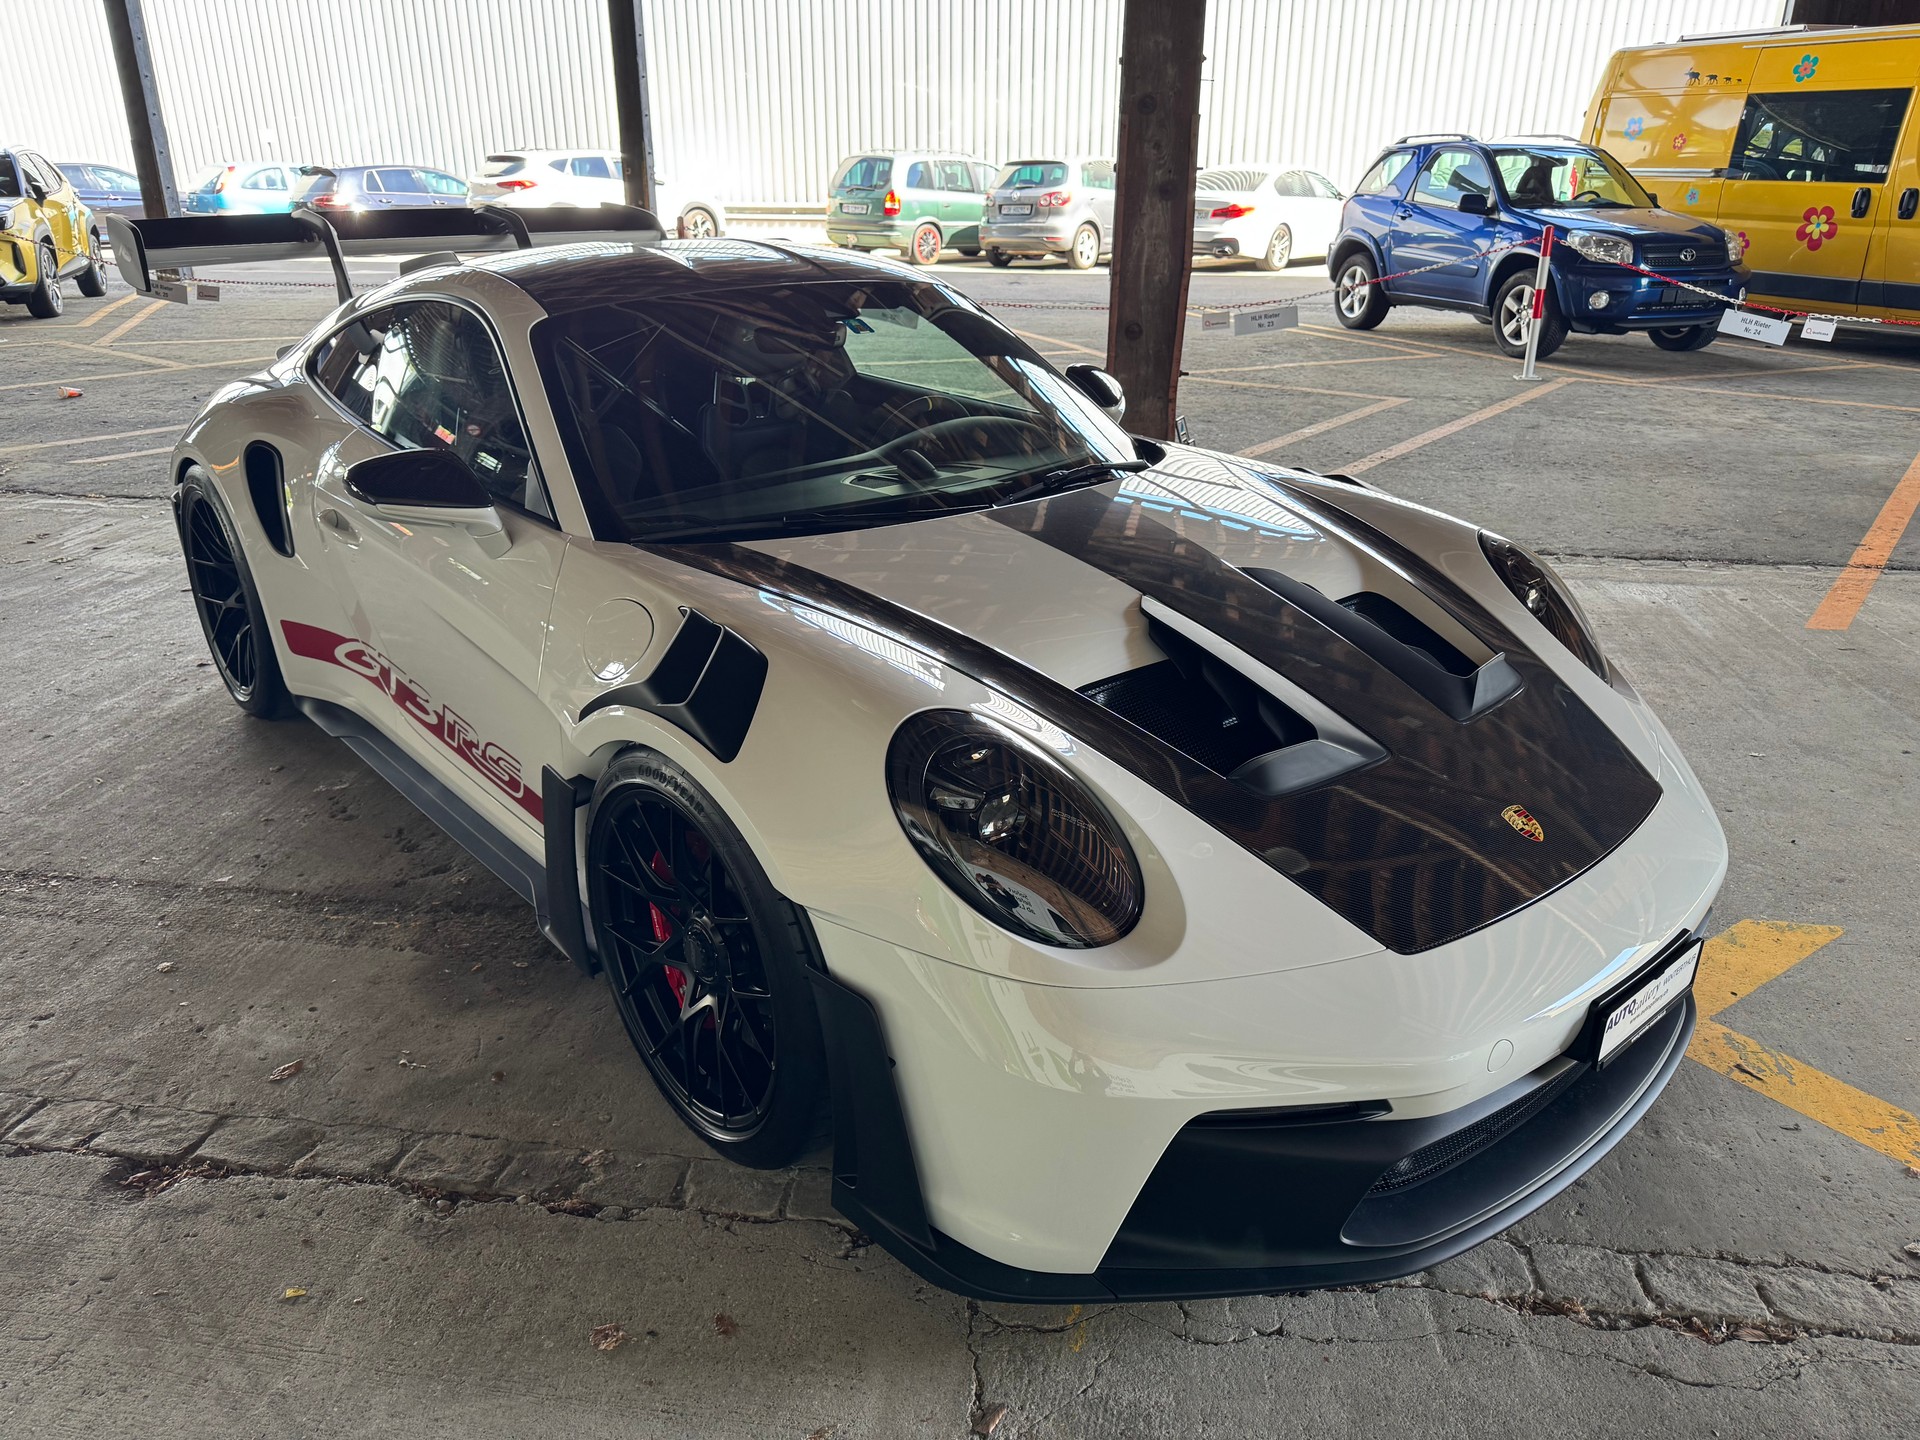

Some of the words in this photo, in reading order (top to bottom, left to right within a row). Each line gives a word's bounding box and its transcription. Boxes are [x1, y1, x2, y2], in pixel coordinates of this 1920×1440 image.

[1263, 312, 1280, 320] Rieter
[1740, 317, 1754, 325] HLH
[1754, 319, 1771, 329] Rieter
[1743, 326, 1752, 334] Nr.
[442, 703, 525, 798] RS
